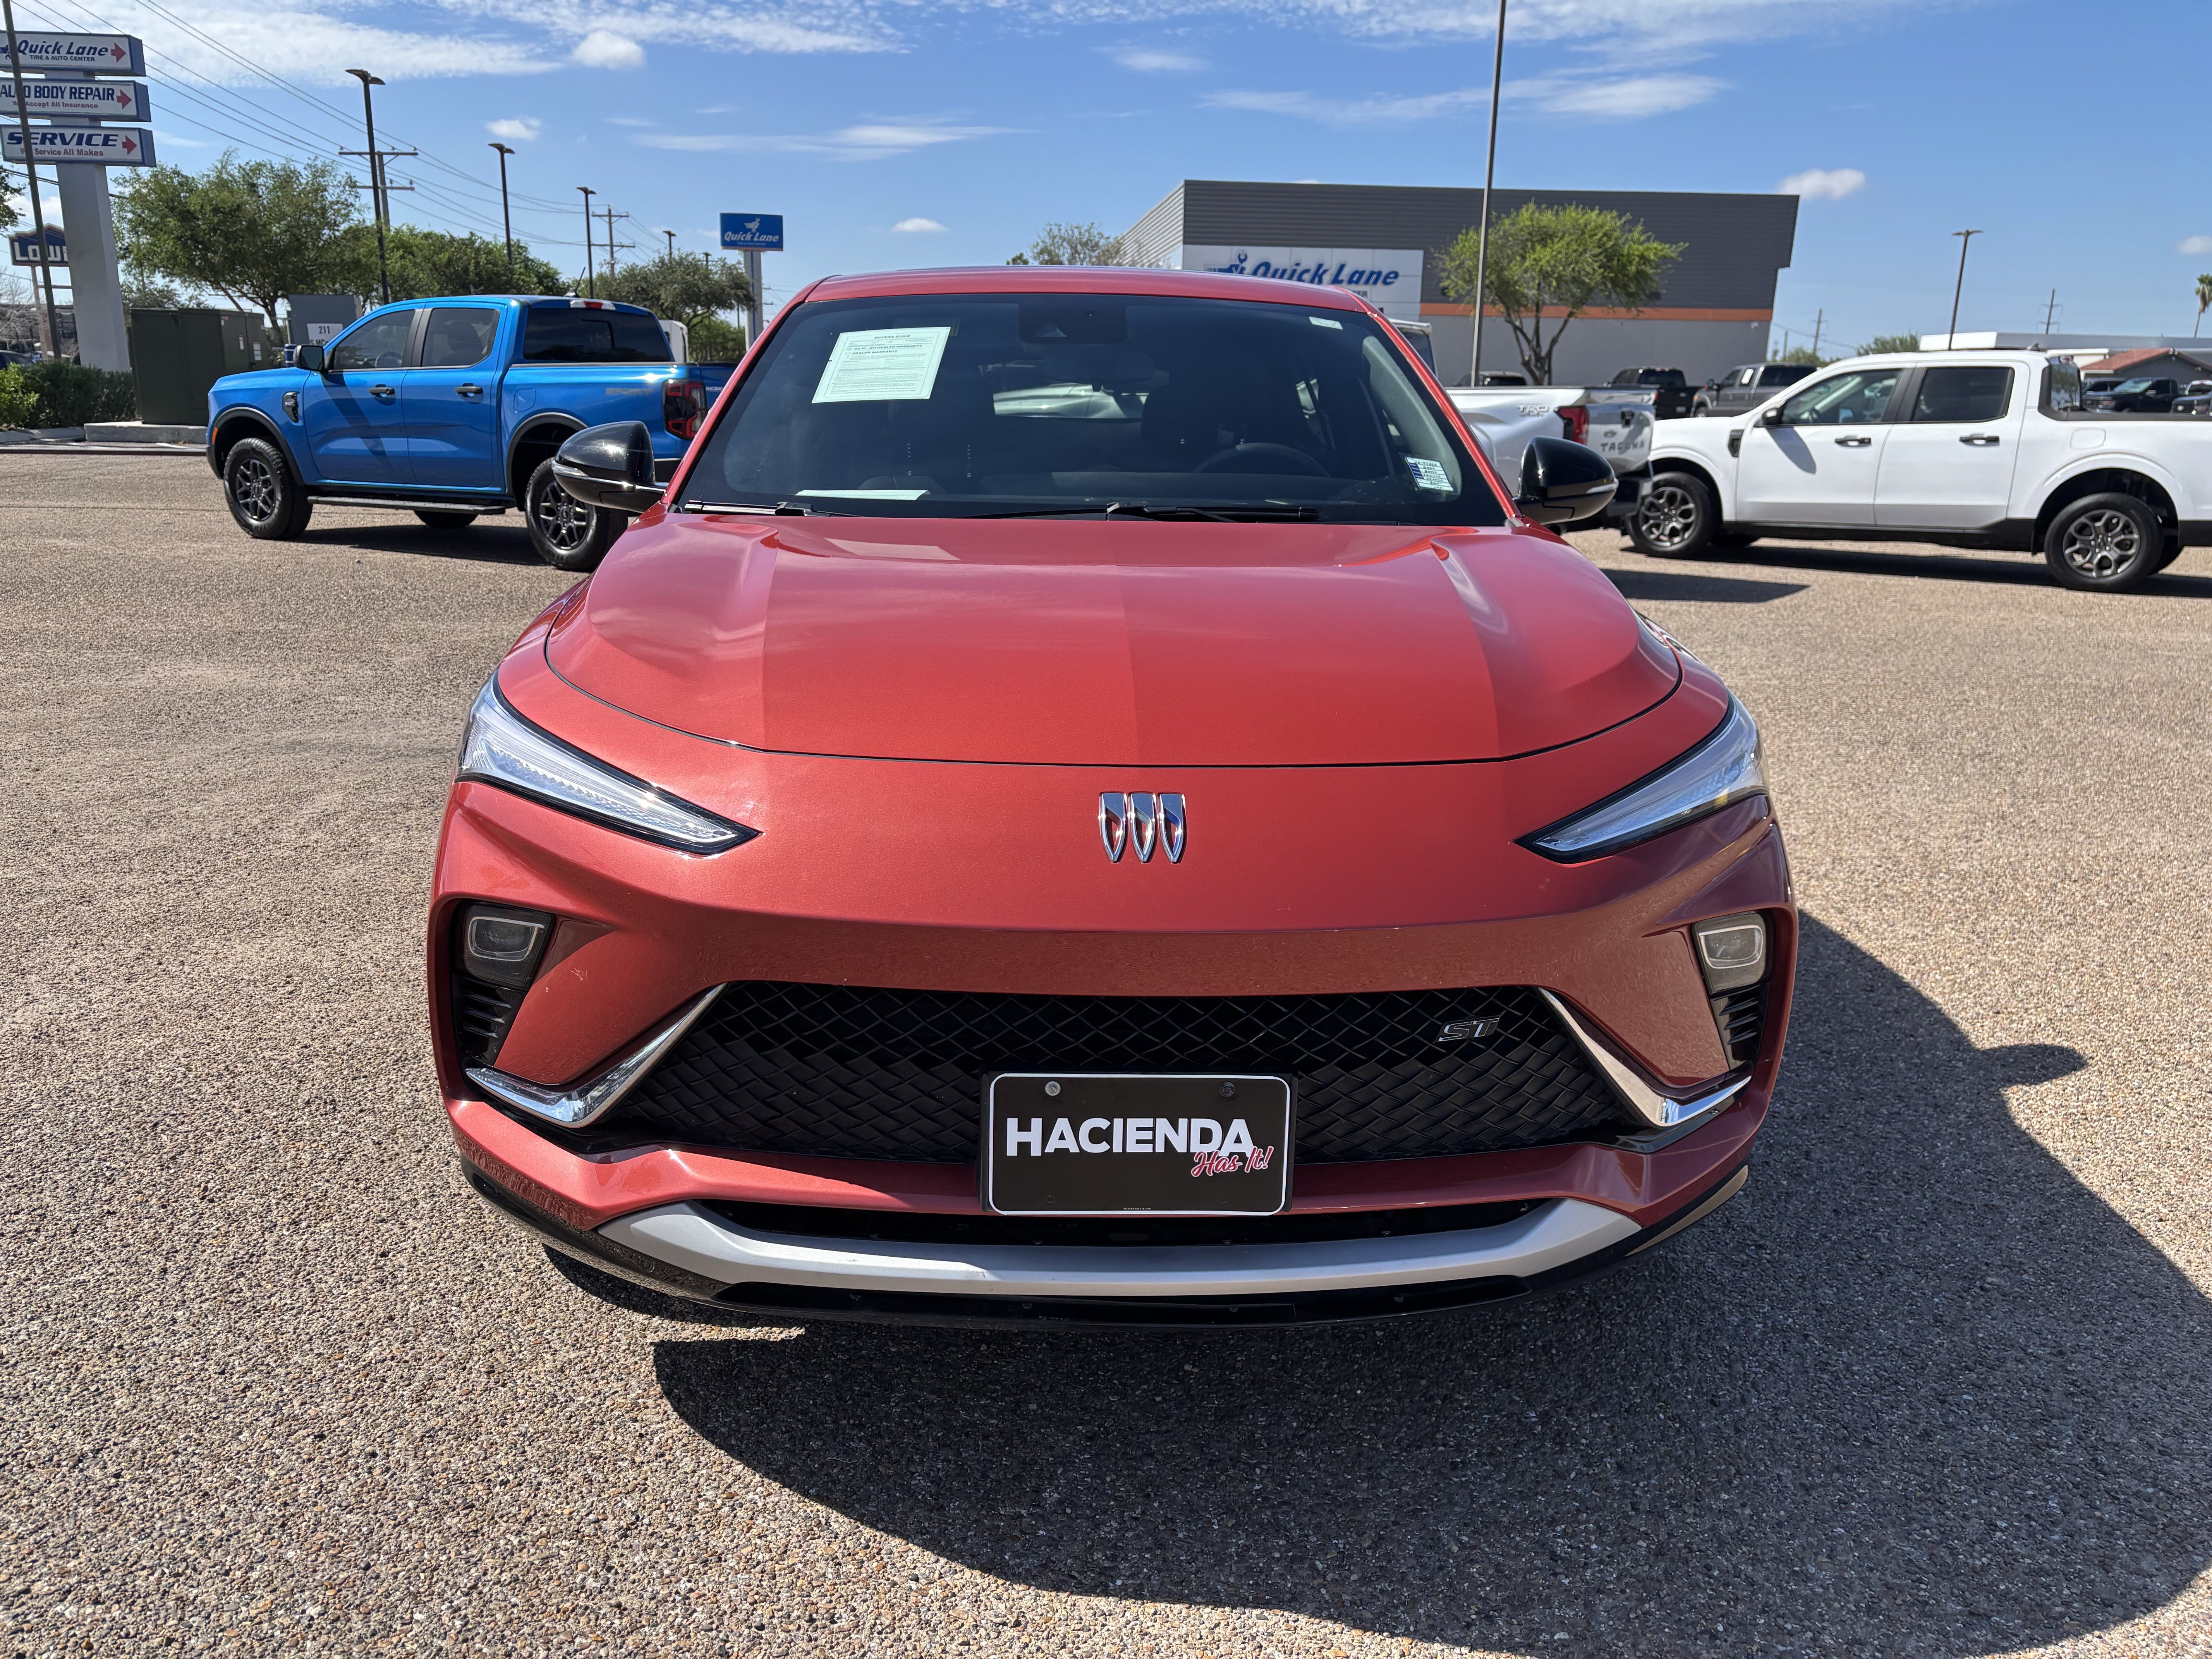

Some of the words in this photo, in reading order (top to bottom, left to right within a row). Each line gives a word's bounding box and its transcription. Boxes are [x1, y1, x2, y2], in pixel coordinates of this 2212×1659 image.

[17, 40, 63, 55] Quick
[65, 42, 108, 56] Lane
[0, 84, 31, 98] AUO
[34, 85, 67, 99] BODY
[69, 86, 114, 101] REPAIR
[7, 132, 118, 146] SERVICE
[724, 231, 752, 241] Quick
[754, 232, 779, 242] Lane
[1331, 264, 1399, 286] Lane
[318, 326, 330, 334] 211
[1438, 1018, 1499, 1042] ST
[1007, 1118, 1254, 1157] HACIENDA
[1191, 1150, 1243, 1177] Has
[1244, 1146, 1274, 1173] It!
